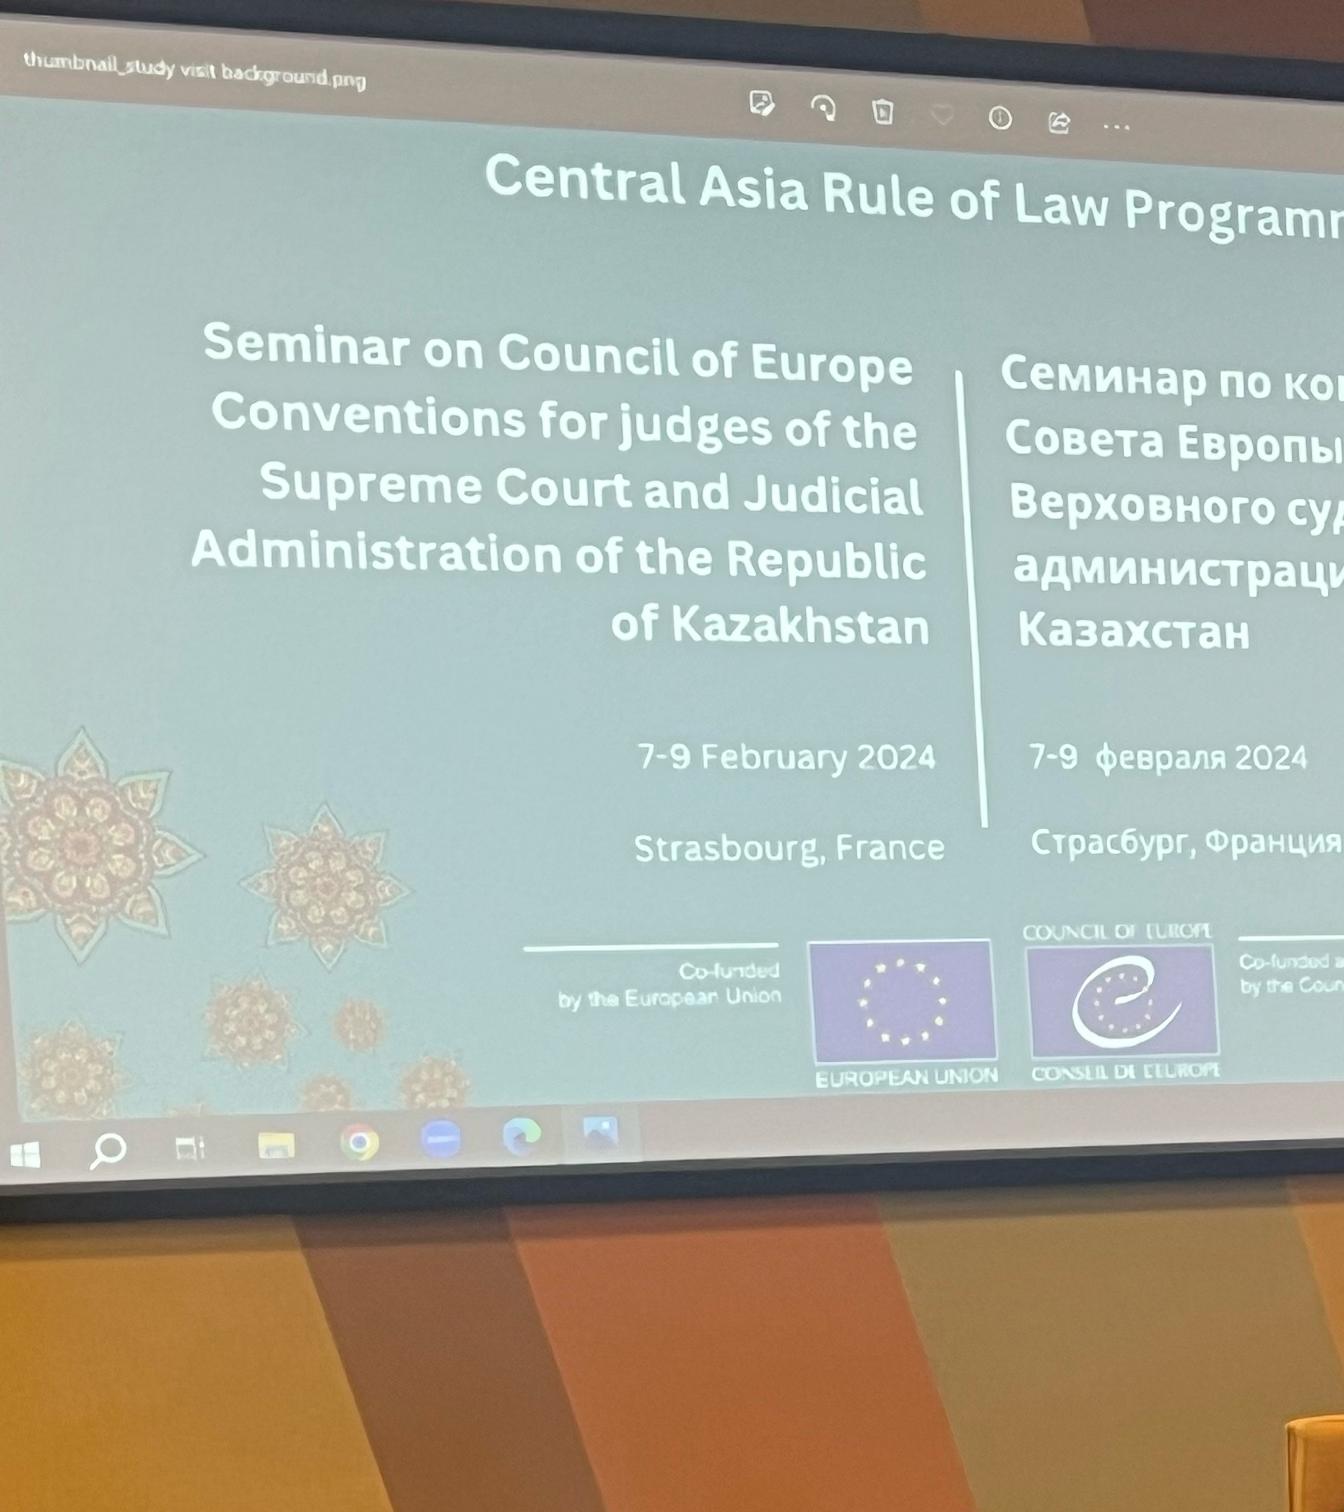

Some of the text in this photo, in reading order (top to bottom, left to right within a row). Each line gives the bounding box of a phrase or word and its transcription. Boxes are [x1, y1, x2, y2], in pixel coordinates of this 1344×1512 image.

[179, 63, 216, 80] visit
[485, 152, 687, 205] Central
[699, 164, 809, 211] Asia
[823, 171, 934, 218] Rule
[950, 178, 1001, 221] of
[1015, 182, 1110, 227] Law
[203, 321, 913, 394] Seminar on Council of Europe
[1001, 353, 1207, 407] Семинар
[1220, 370, 1272, 399] по
[211, 390, 917, 455] Conventions for judges of the
[1005, 418, 1164, 458] Совета
[1178, 424, 1343, 472] Европы
[260, 460, 925, 516] Supreme Court and Judicial
[1010, 482, 1276, 531] Верховного
[191, 528, 927, 588] Administration of the Republic
[611, 602, 929, 645] of Kazakhstan
[1019, 610, 1250, 650] Казахстан
[637, 742, 936, 779] 7-9 February 2024
[1029, 741, 1308, 777] 7-9 февраля 2024
[634, 833, 945, 869] Strasbourg, France
[1031, 827, 1342, 862] Страсбург, Франция
[1022, 922, 1213, 941] COUNCIL OF EUROPE
[678, 962, 780, 980] Co-funded
[1238, 953, 1330, 970] Co-funded
[557, 986, 782, 1013] by the European Union
[1239, 978, 1261, 998] by
[1265, 979, 1294, 994] the
[814, 1067, 999, 1089] EUROPEAN UNION
[1030, 1065, 1108, 1082] CONSEIL
[1113, 1064, 1136, 1079] DE
